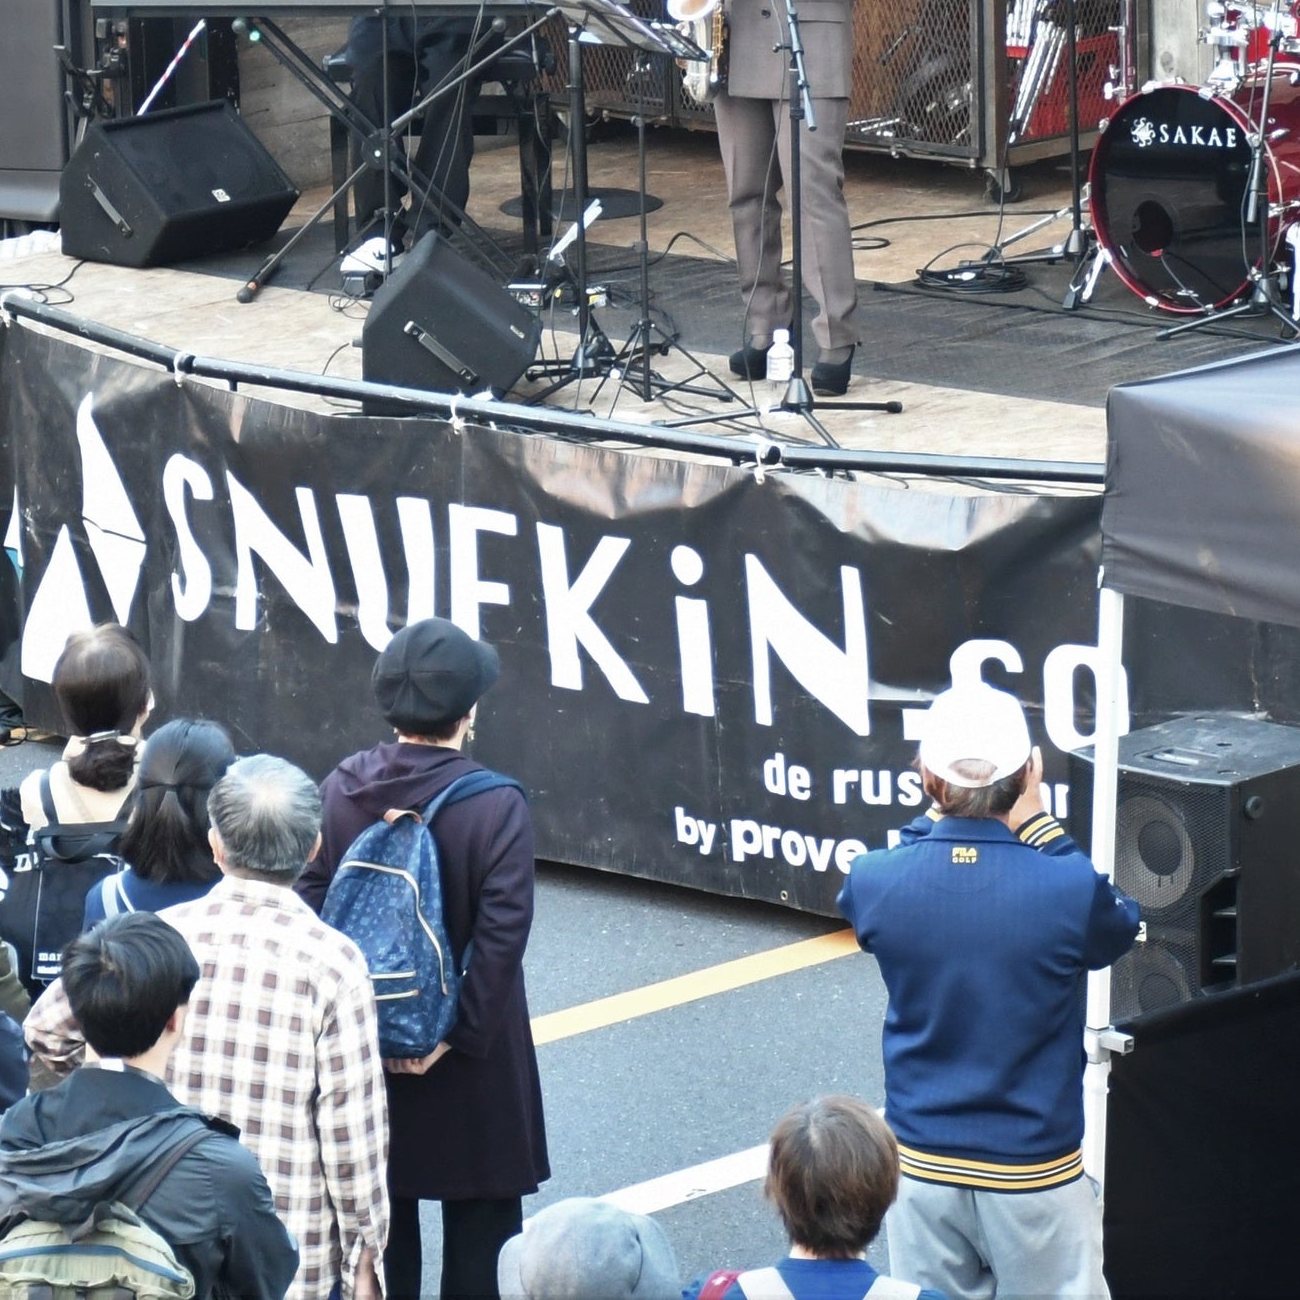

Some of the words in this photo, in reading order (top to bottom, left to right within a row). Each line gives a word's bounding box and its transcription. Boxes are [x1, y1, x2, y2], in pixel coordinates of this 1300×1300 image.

[1159, 123, 1237, 147] SAKAE
[763, 753, 811, 801] de
[674, 806, 716, 855] by
